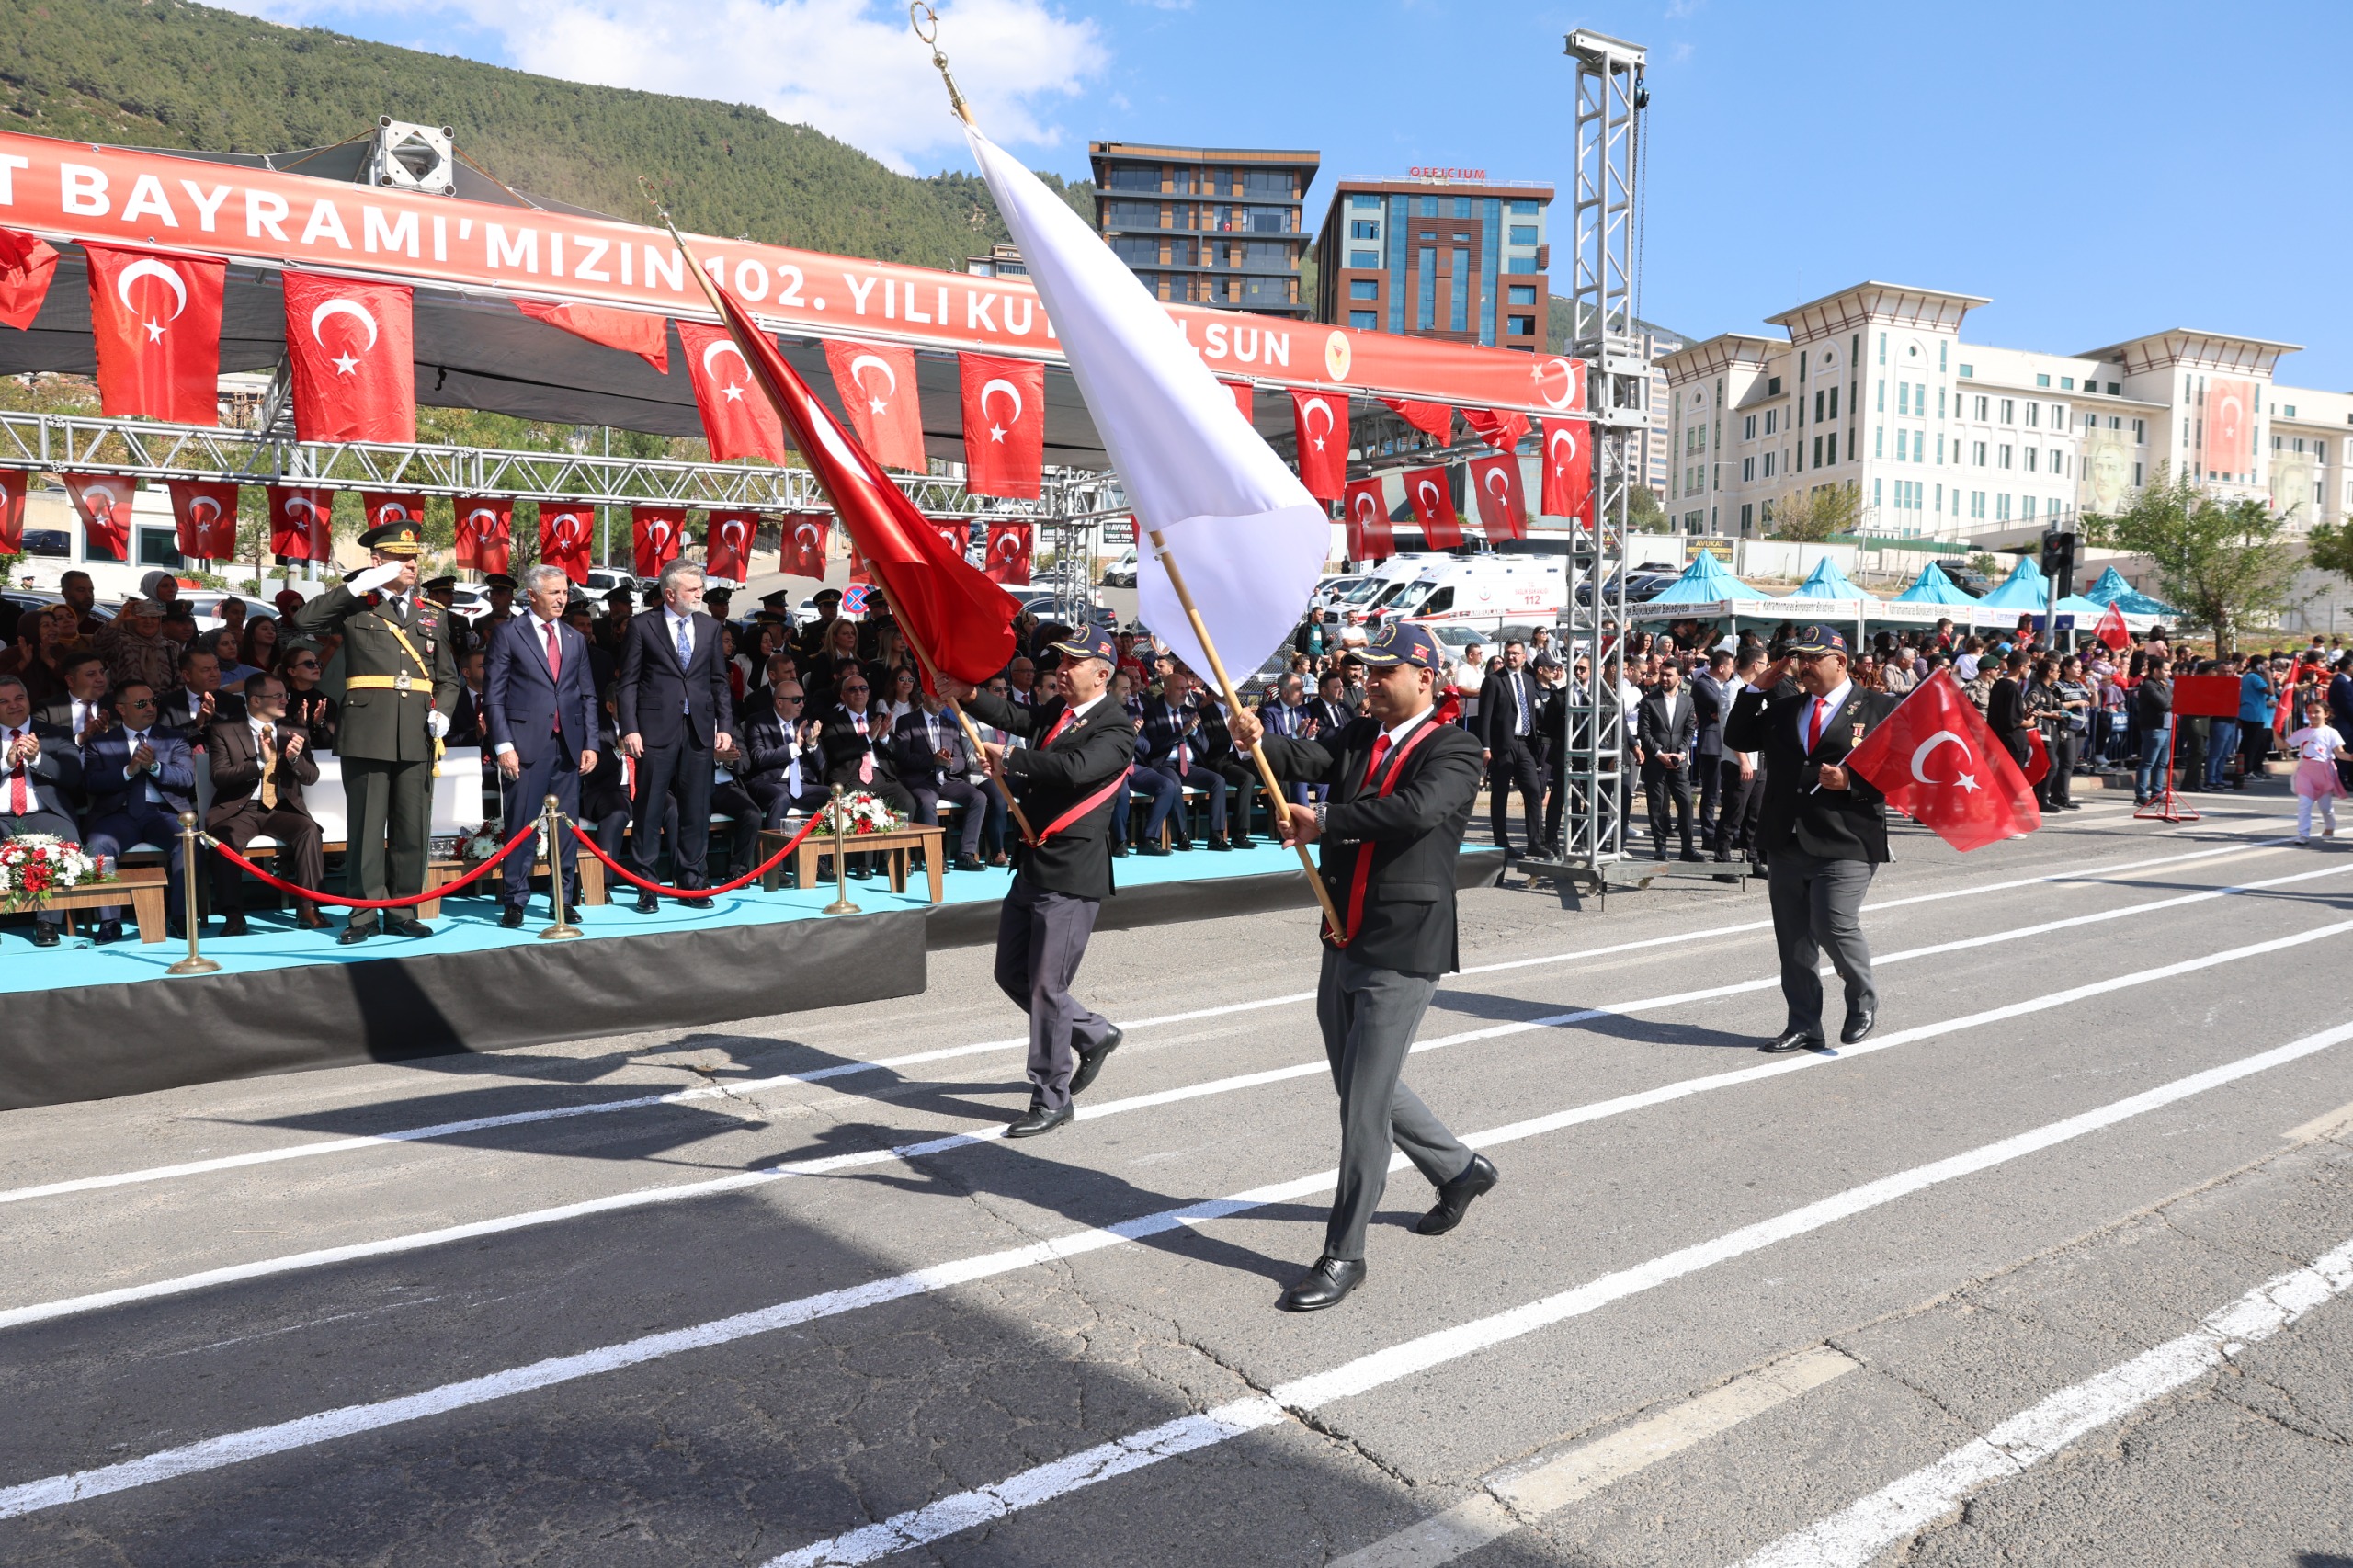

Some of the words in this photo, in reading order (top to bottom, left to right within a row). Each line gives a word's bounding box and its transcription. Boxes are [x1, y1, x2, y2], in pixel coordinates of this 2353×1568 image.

[1410, 166, 1485, 179] OFFICIUM
[705, 256, 826, 311] 102.
[844, 273, 949, 325] YILI
[1178, 319, 1290, 367] LSUN
[1524, 595, 1540, 605] 112
[1662, 602, 1690, 615] Belediyesi
